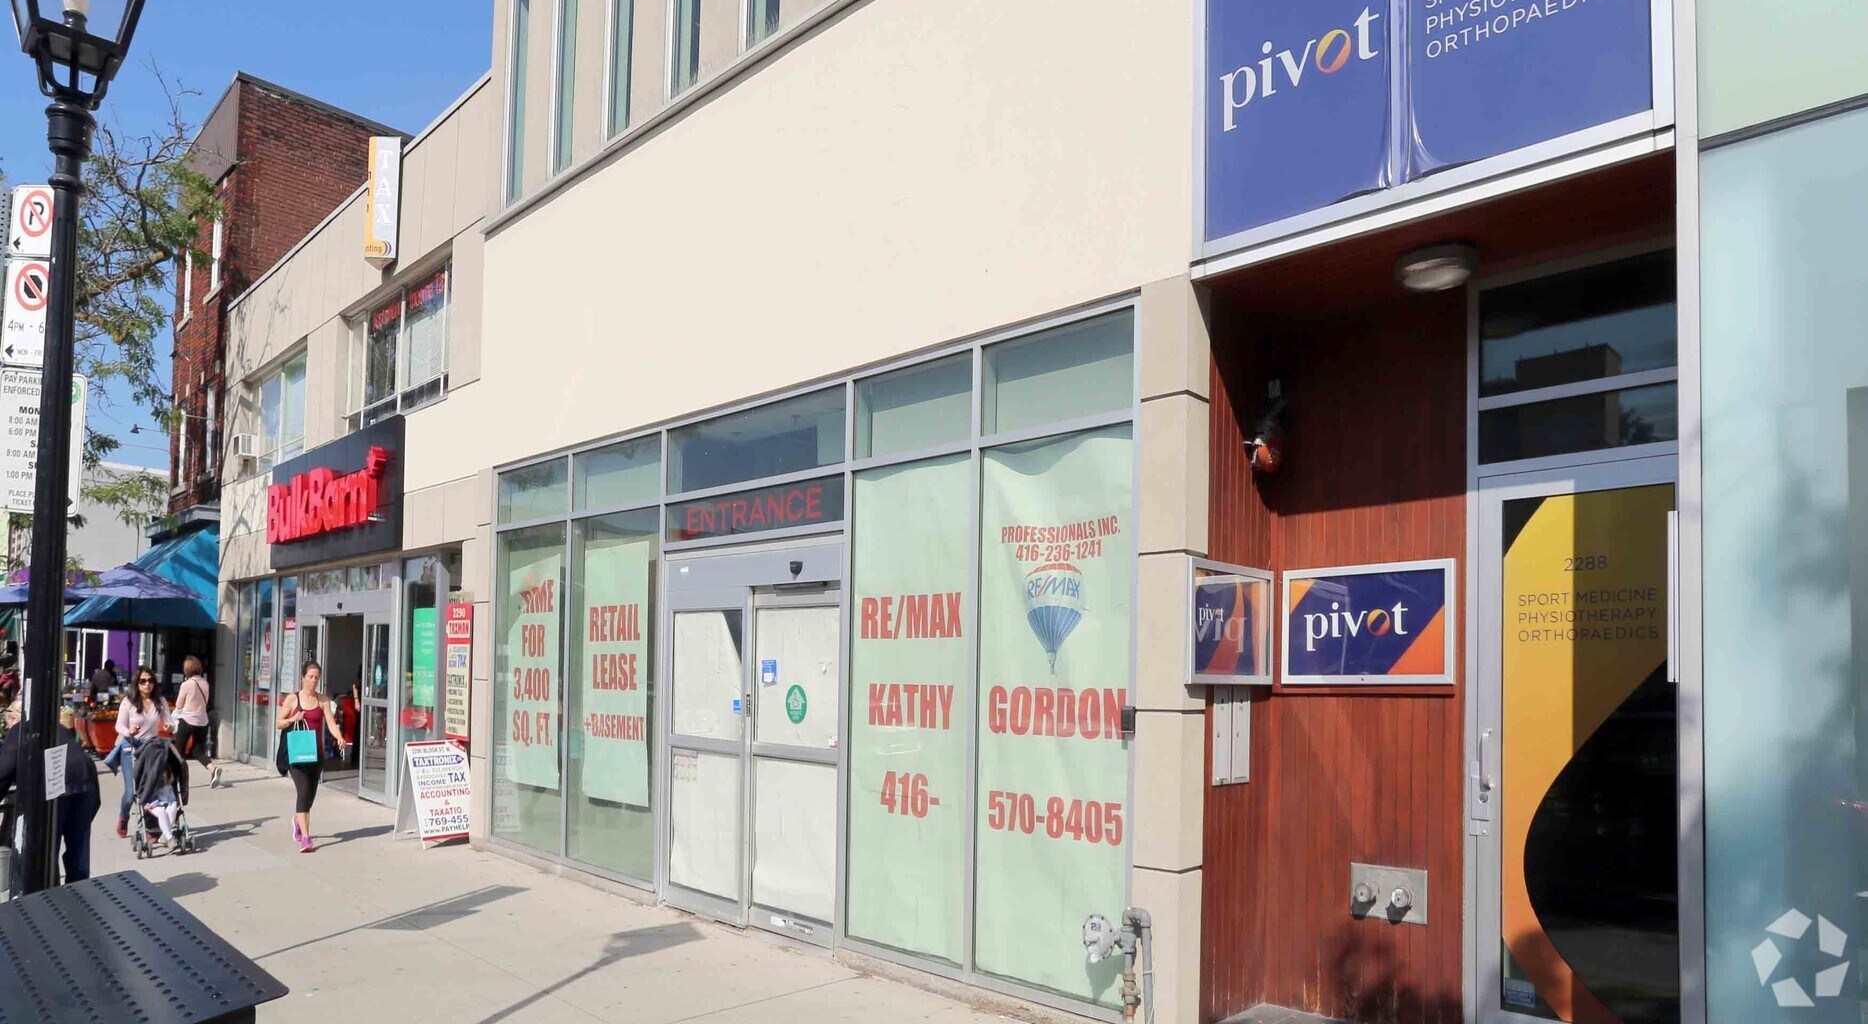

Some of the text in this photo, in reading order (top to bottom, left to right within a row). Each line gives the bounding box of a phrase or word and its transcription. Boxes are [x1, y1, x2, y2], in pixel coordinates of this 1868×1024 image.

[1219, 6, 1380, 133] pivot
[376, 149, 394, 225] TAX
[8, 320, 25, 333] 4PM
[4, 375, 18, 383] PAY
[3, 386, 41, 396] ENFORCED
[8, 416, 38, 426] 8:00 AM
[8, 427, 37, 437] 6:00 PM
[6, 449, 36, 458] 8:00 AM
[6, 471, 33, 480] 1:00 PM
[12, 498, 32, 506] TICKET
[686, 487, 823, 535] ENTRANCE
[1001, 515, 1120, 544] PROFESSIONALS INC.
[1015, 539, 1102, 562] 416-236-1241
[1563, 556, 1608, 572] 2288
[1027, 575, 1082, 600] RE/MAX
[1518, 588, 1657, 607] SPORT MEDICINE
[589, 604, 641, 642] RETAIL
[860, 592, 962, 640] RE/MAX
[1198, 603, 1225, 626] pivot
[1304, 600, 1408, 652] pivot
[1518, 607, 1657, 624] PHYSIOTHERAPY
[521, 624, 545, 657] FOR
[1518, 626, 1659, 642] ORTHOPAEDICS
[592, 653, 638, 691] LEASE
[513, 668, 550, 703] 3,400
[868, 683, 954, 730] KATHY
[988, 684, 1127, 740] GORDON
[512, 710, 553, 746] SQ. FT.
[413, 755, 457, 766] TAXTRONIX
[418, 779, 446, 787] INCOME
[447, 772, 466, 783] TAX
[420, 787, 471, 799] ACCOUNTING
[880, 770, 941, 819] 416-
[988, 790, 1123, 846] 570-8405
